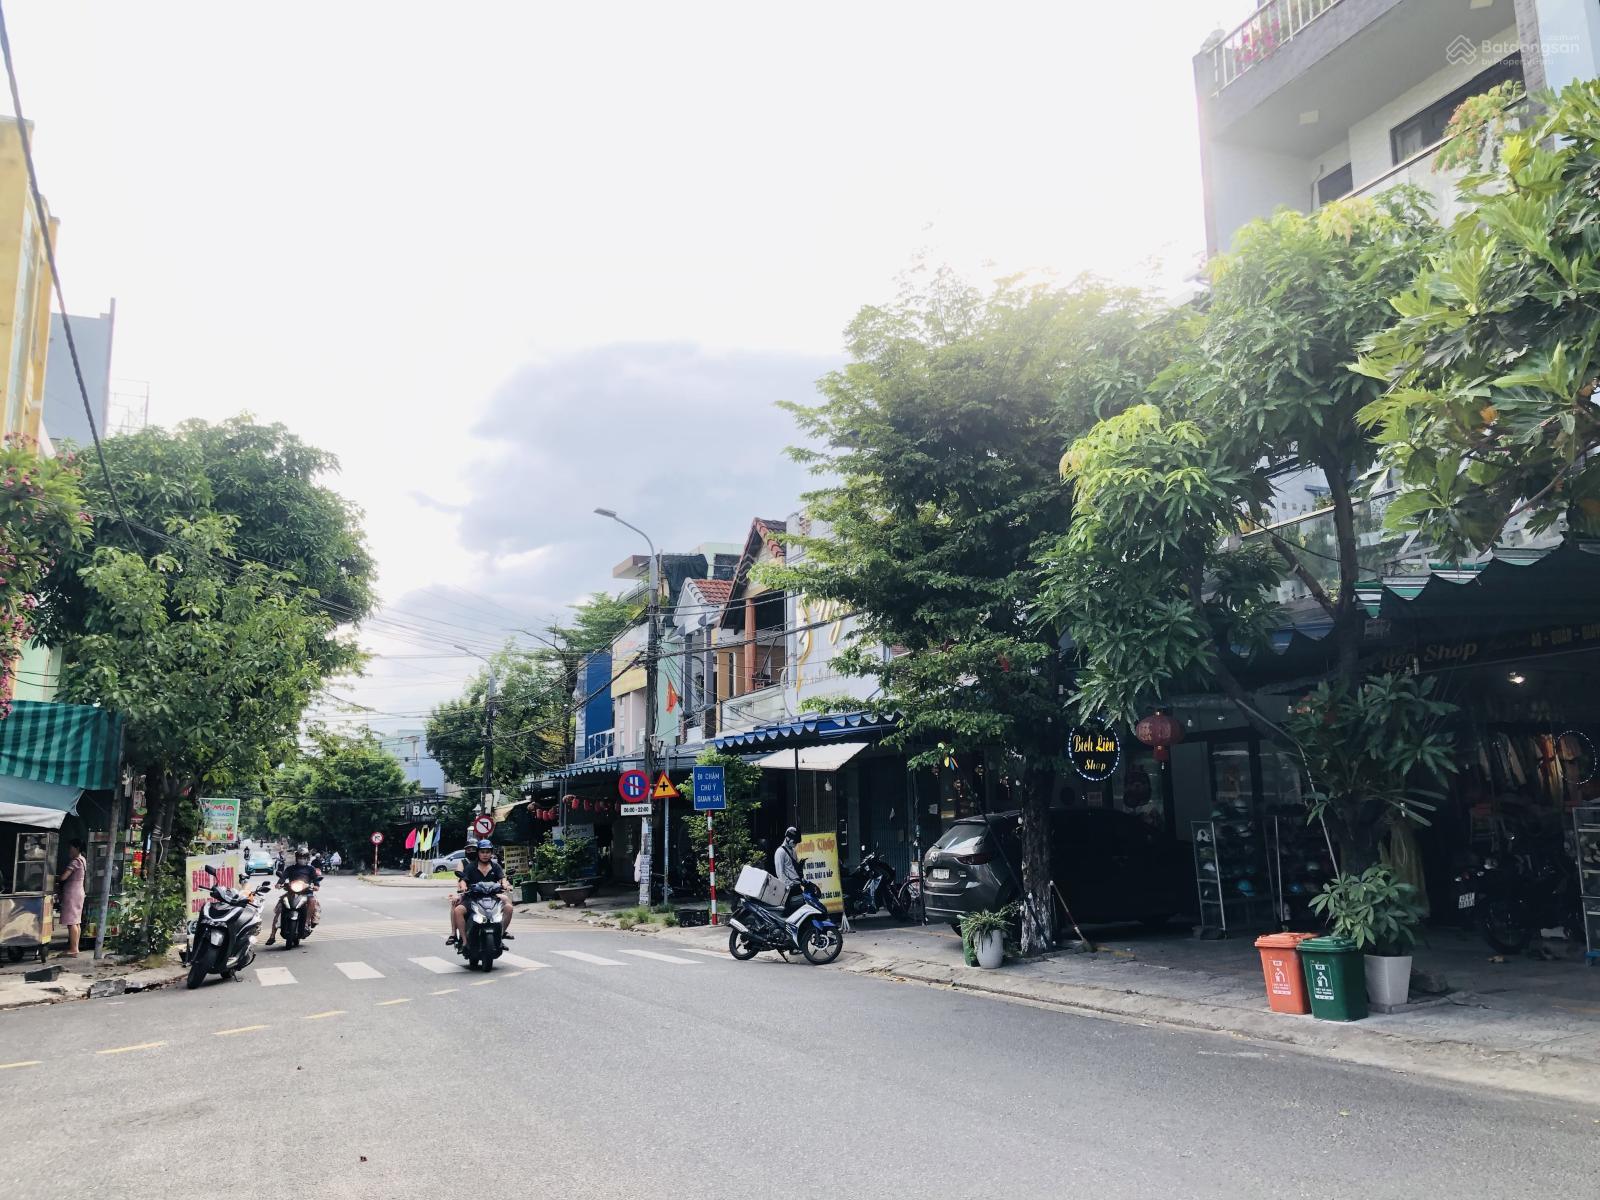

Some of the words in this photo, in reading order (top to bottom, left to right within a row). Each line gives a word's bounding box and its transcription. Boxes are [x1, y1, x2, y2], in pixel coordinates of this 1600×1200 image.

[1423, 642, 1478, 662] Shop
[1095, 734, 1115, 752] Liên
[1084, 758, 1106, 772] Shop
